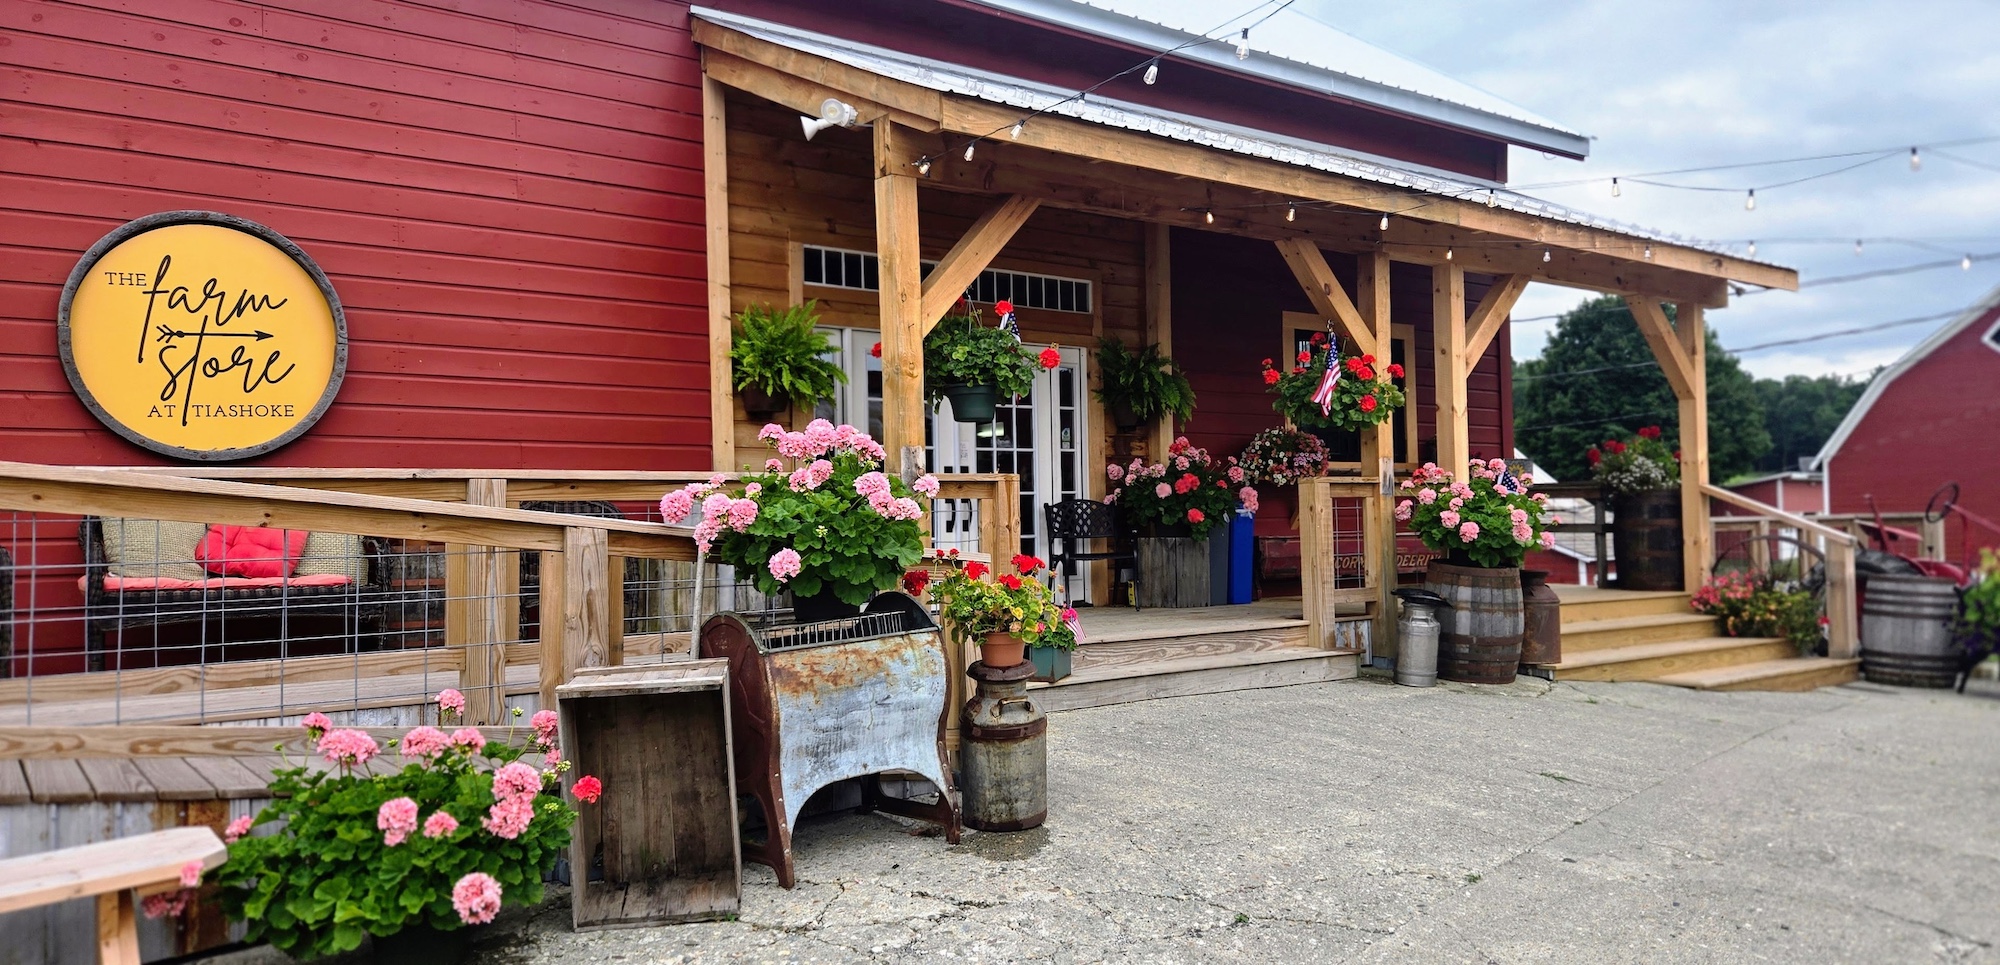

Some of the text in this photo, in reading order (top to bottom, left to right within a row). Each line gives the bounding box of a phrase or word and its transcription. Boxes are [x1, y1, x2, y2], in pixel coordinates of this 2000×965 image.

[104, 254, 288, 363] THE farm
[147, 404, 295, 418] AT TIASHOKE
[158, 315, 296, 427] store
